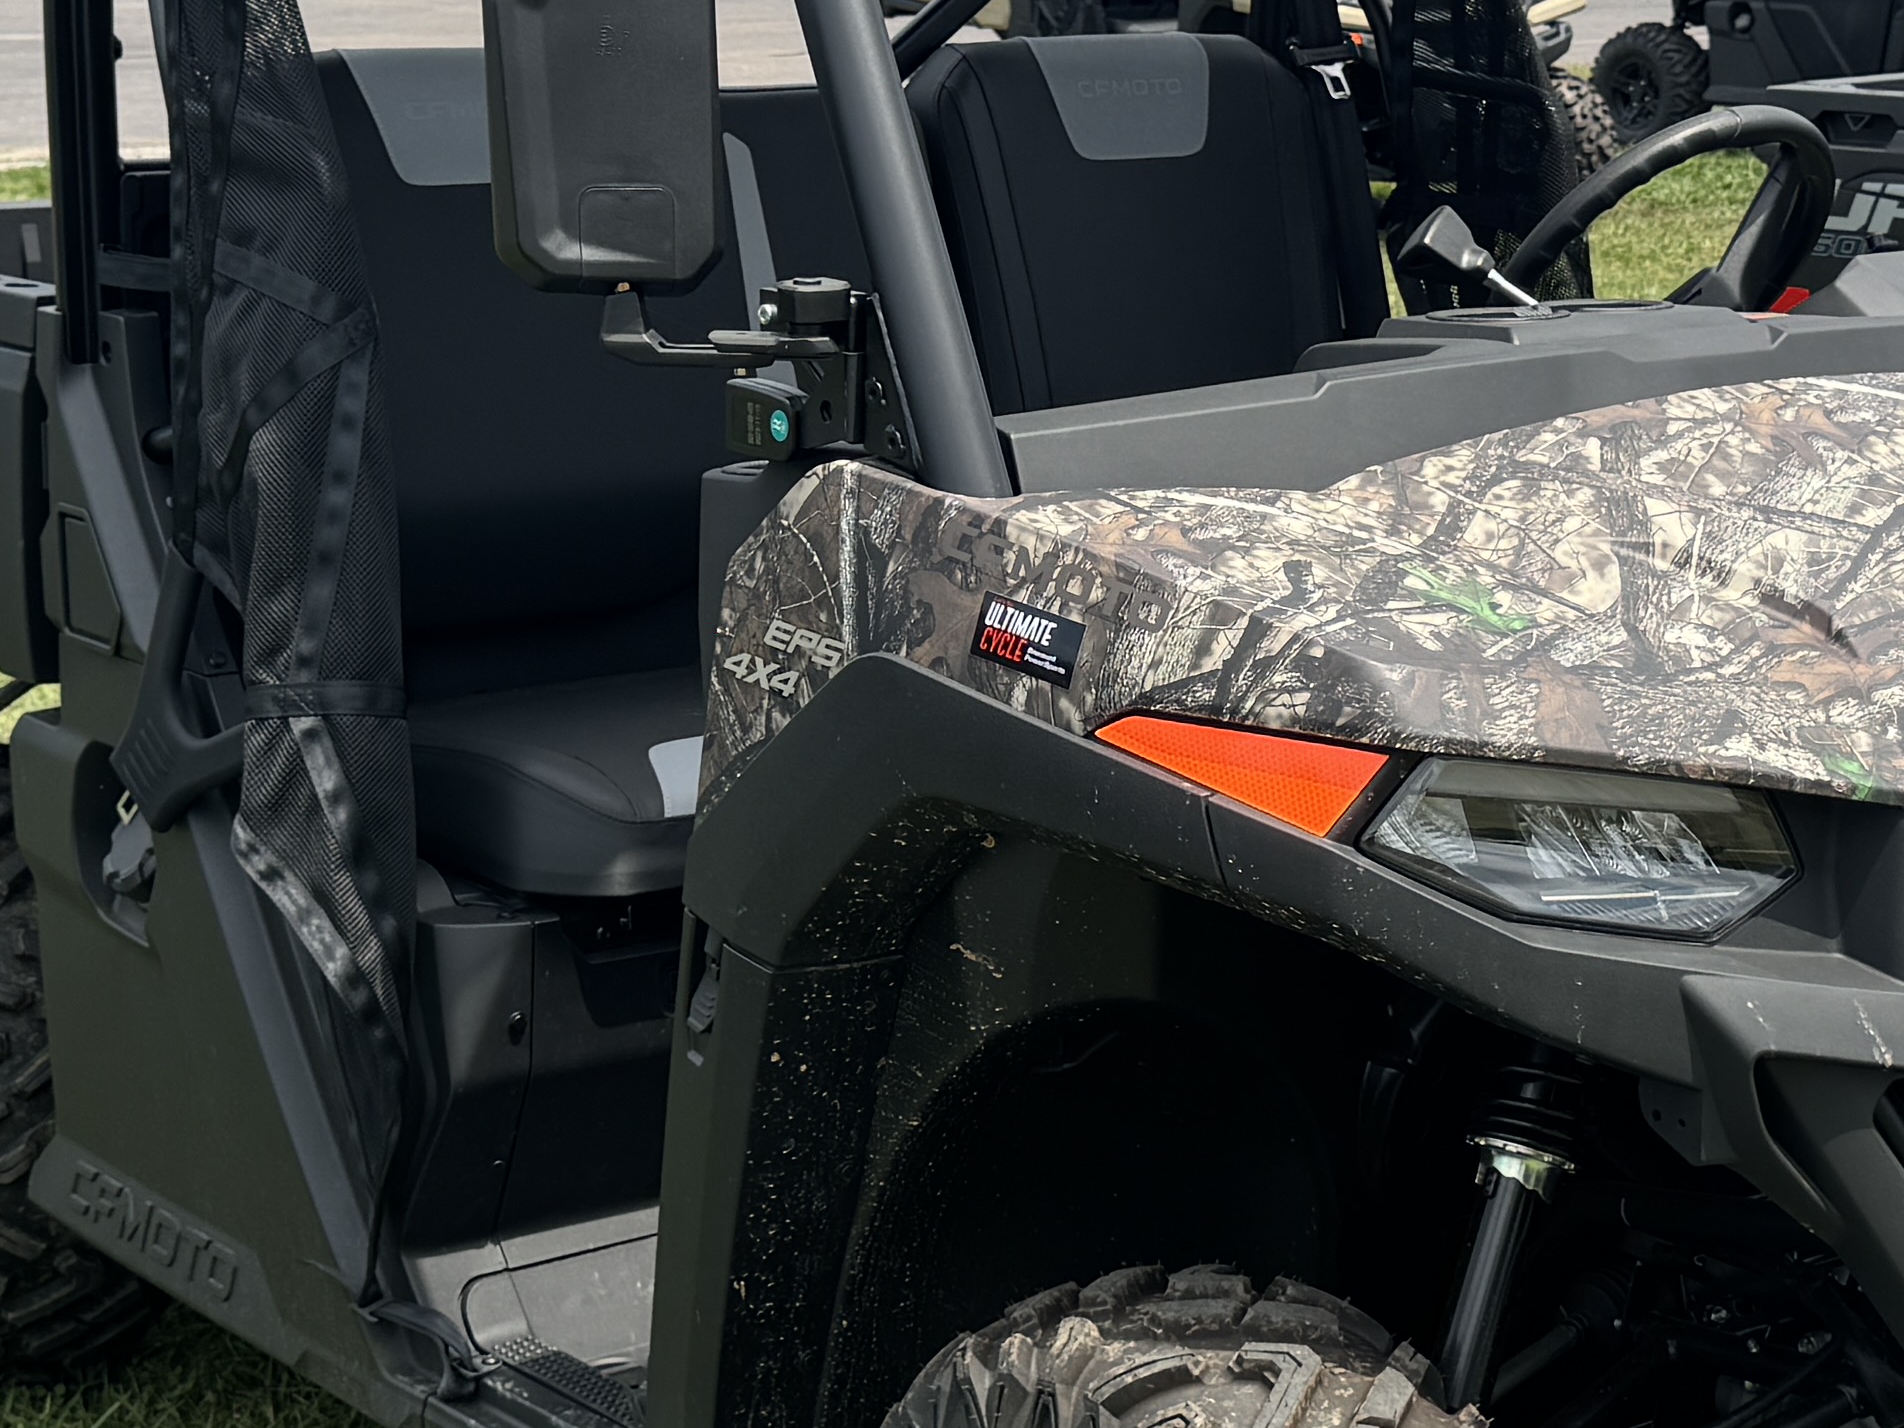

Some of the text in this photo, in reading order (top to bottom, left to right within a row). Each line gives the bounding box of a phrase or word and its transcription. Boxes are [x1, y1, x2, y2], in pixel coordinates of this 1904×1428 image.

[939, 518, 1175, 634] CFMOTO
[763, 618, 847, 668] EPS
[979, 627, 1029, 662] CYCLE
[984, 600, 1059, 647] ULTIMATE
[722, 652, 801, 699] 4X4
[68, 1160, 240, 1303] CFMOTO
